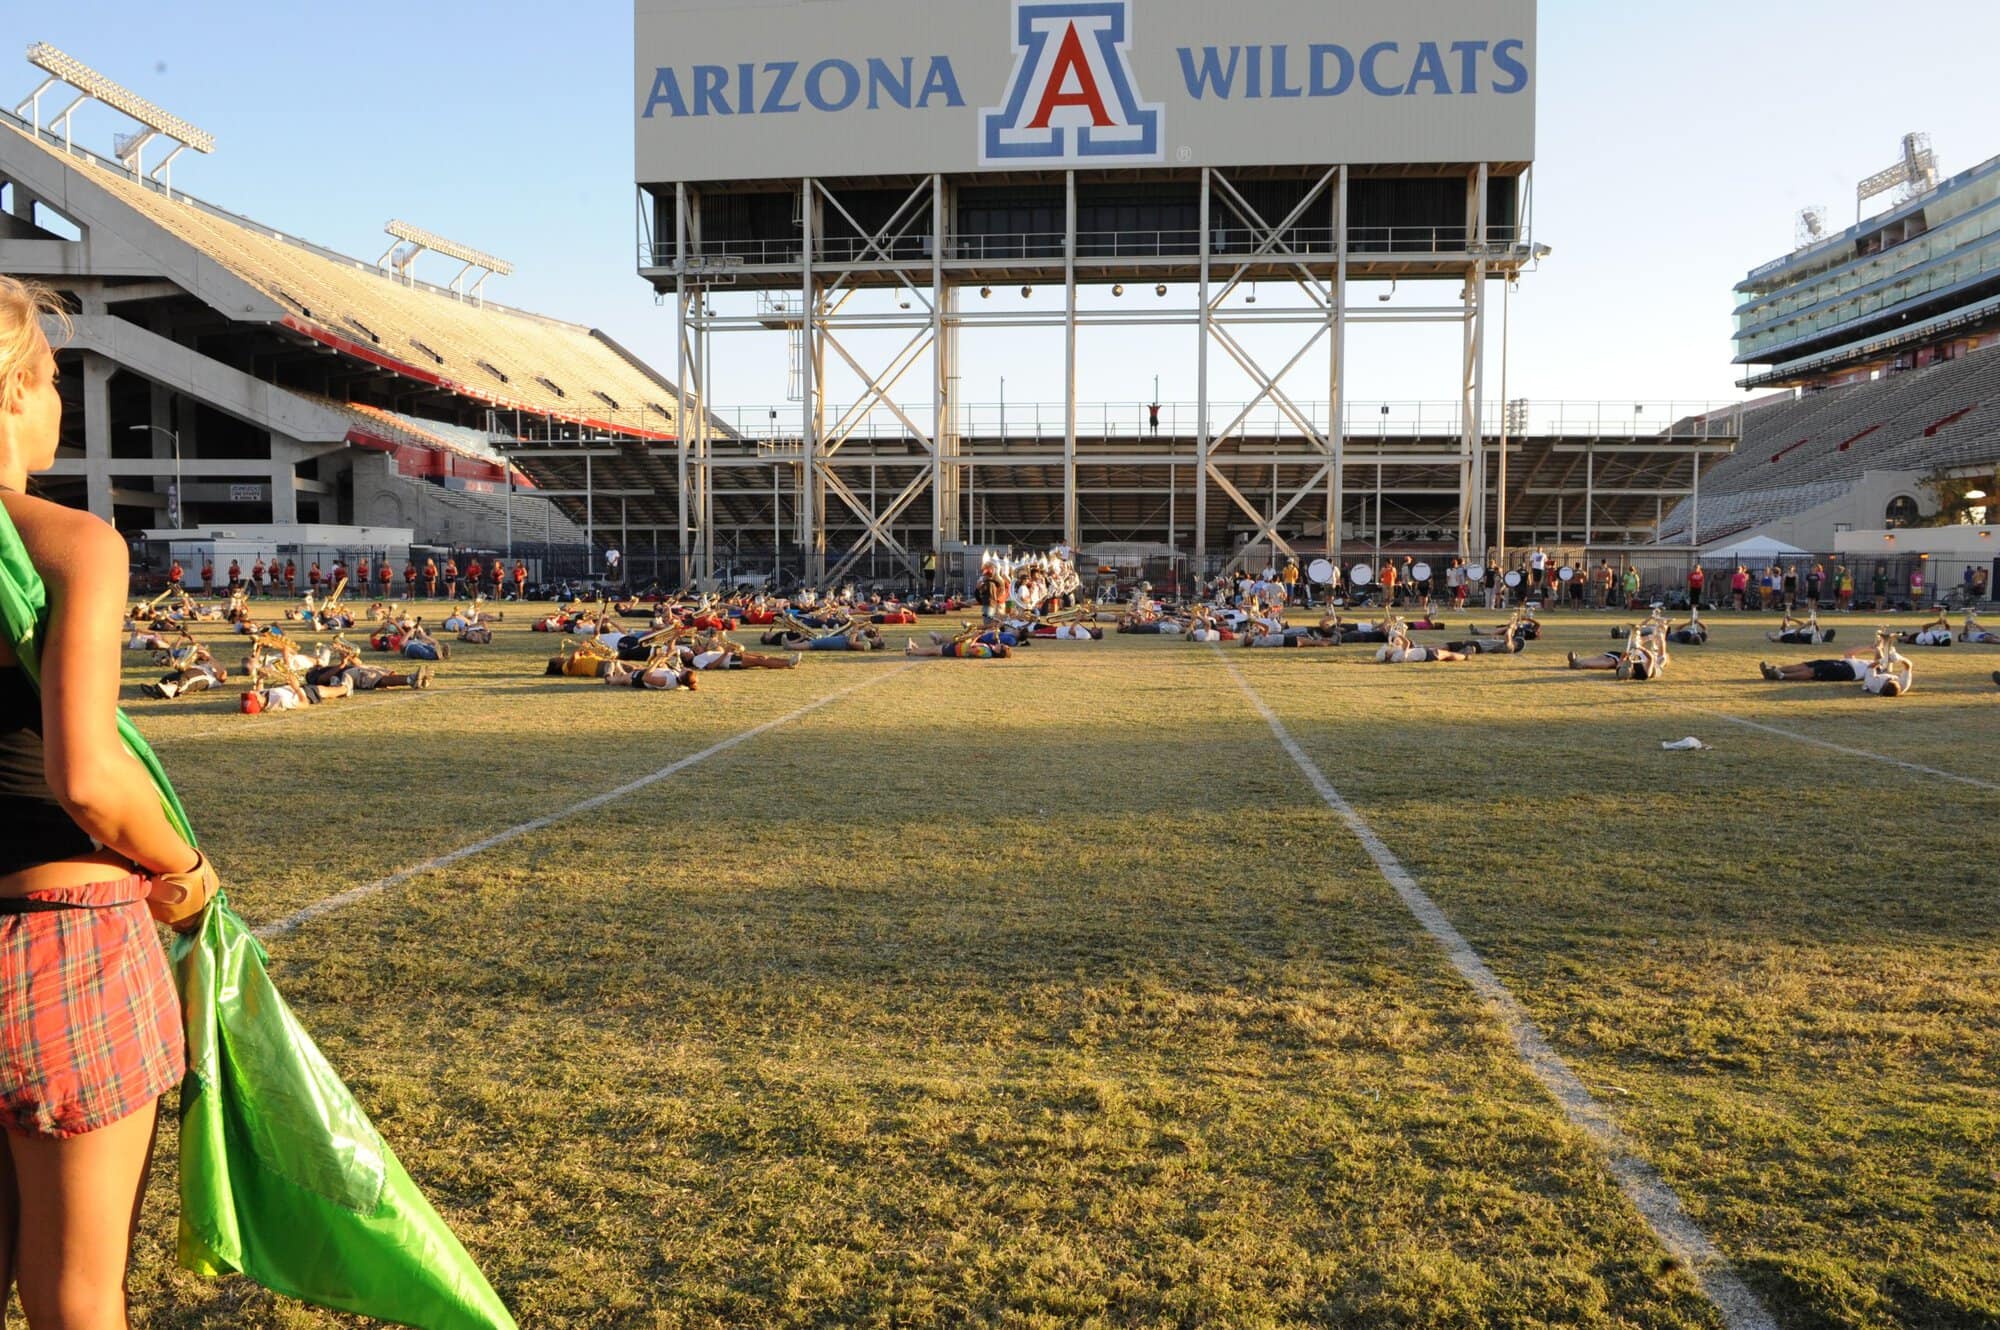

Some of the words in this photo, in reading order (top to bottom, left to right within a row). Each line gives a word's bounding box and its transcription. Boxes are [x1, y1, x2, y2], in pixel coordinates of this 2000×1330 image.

[641, 56, 966, 118] ARIZONA
[983, 1, 1159, 160] A
[1176, 39, 1528, 100] WILDCATS
